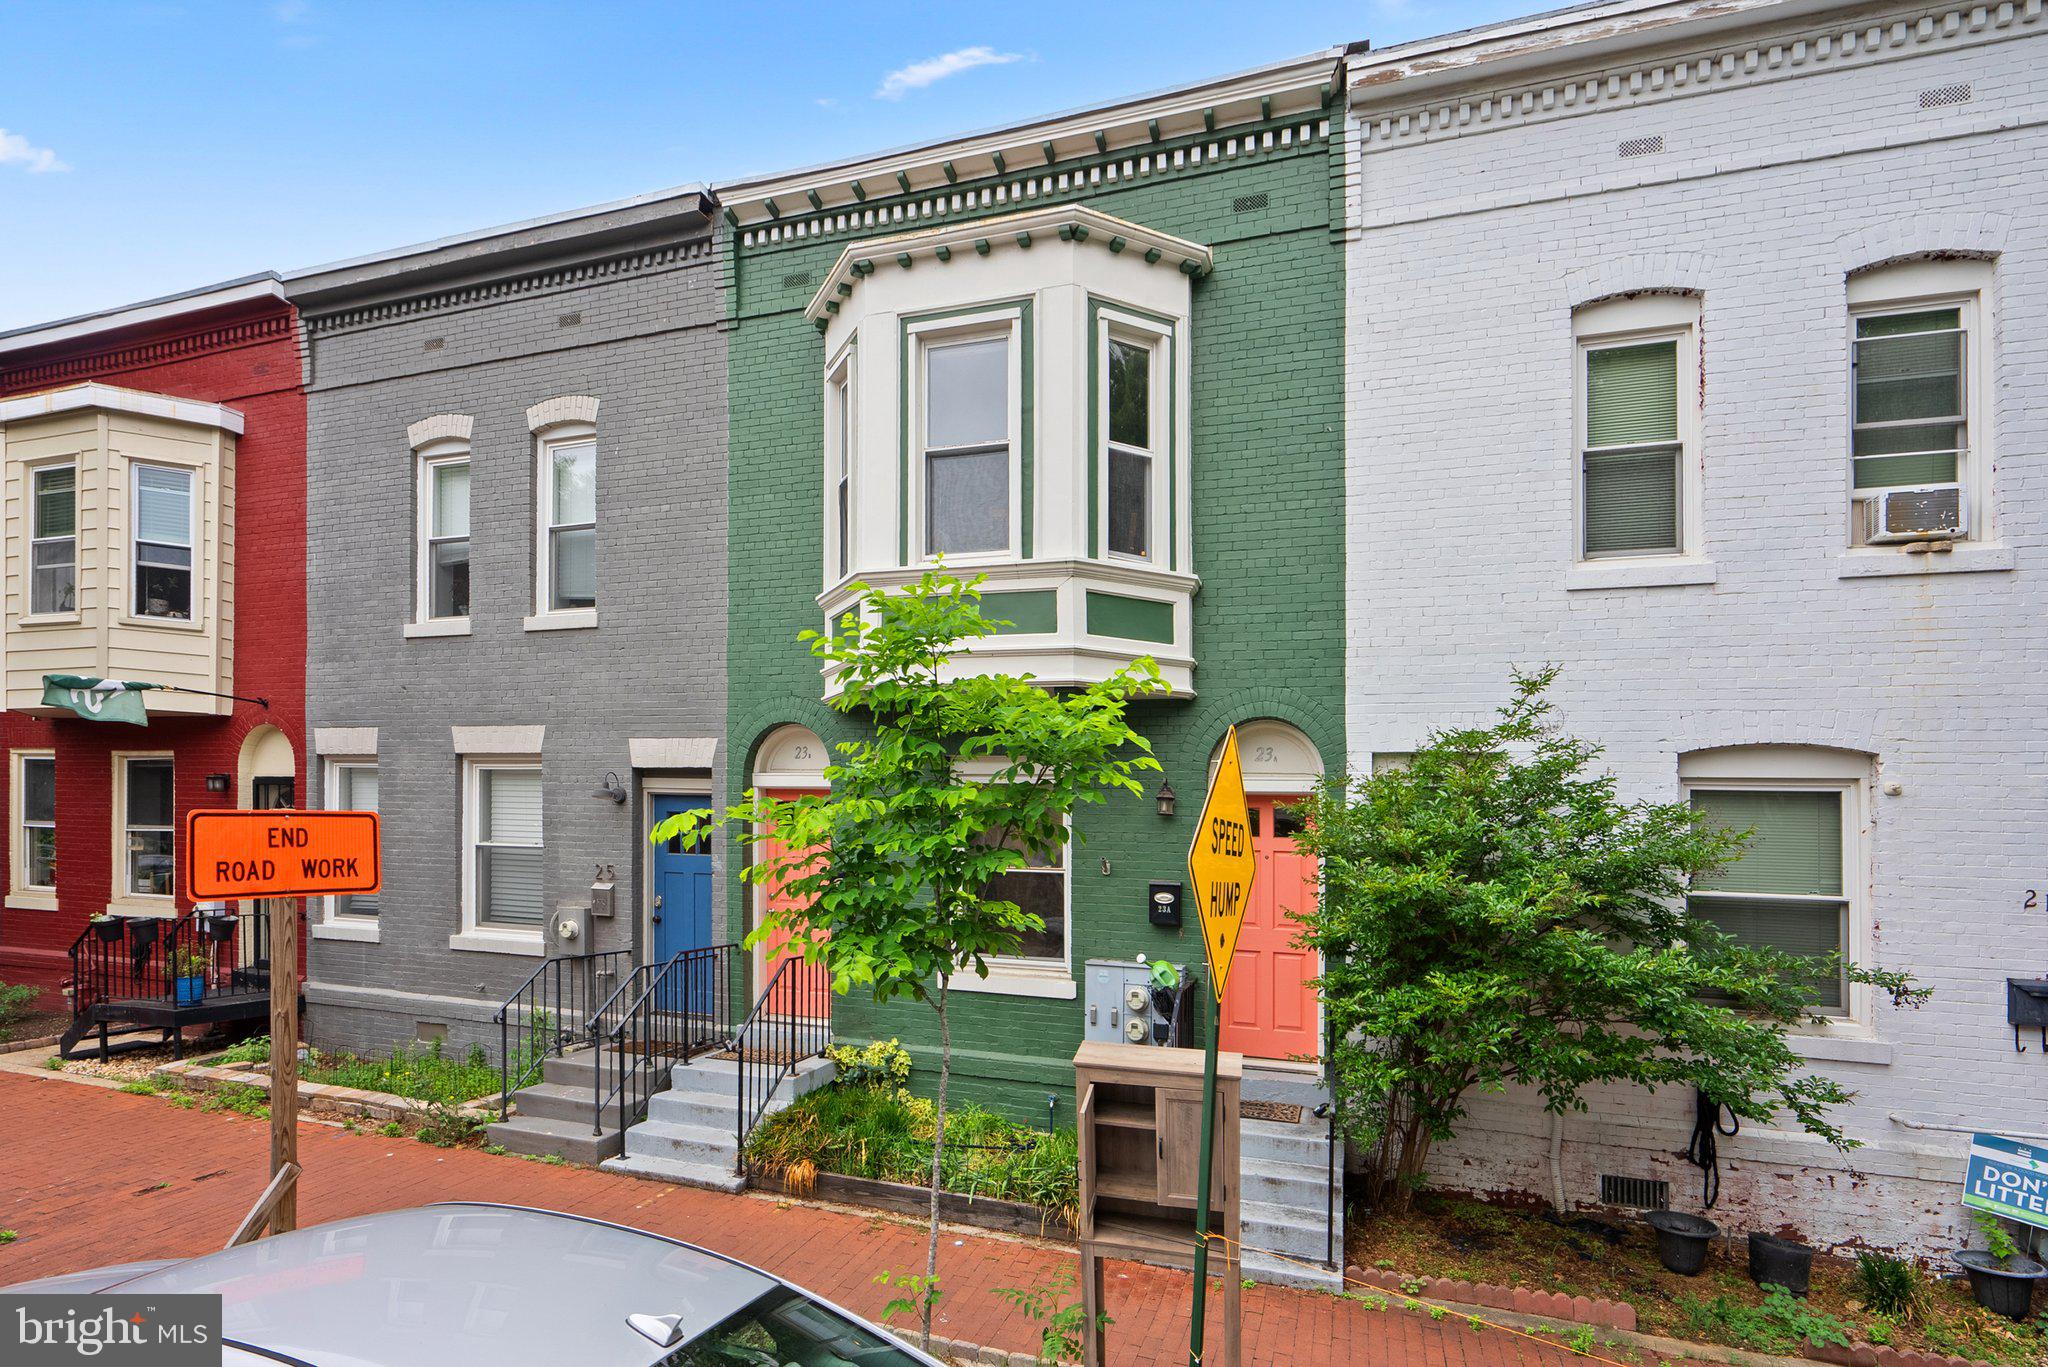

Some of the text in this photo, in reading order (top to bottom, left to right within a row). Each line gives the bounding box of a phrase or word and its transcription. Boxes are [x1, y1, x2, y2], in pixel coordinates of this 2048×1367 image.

[1255, 746, 1278, 762] 23A
[268, 827, 308, 848] END
[1211, 816, 1245, 857] SPEED
[216, 857, 358, 882] ROAD WORK
[595, 864, 615, 880] 25
[1158, 905, 1171, 913] 23A
[1210, 881, 1241, 917] HUMP
[1975, 1180, 2048, 1214] LITTE
